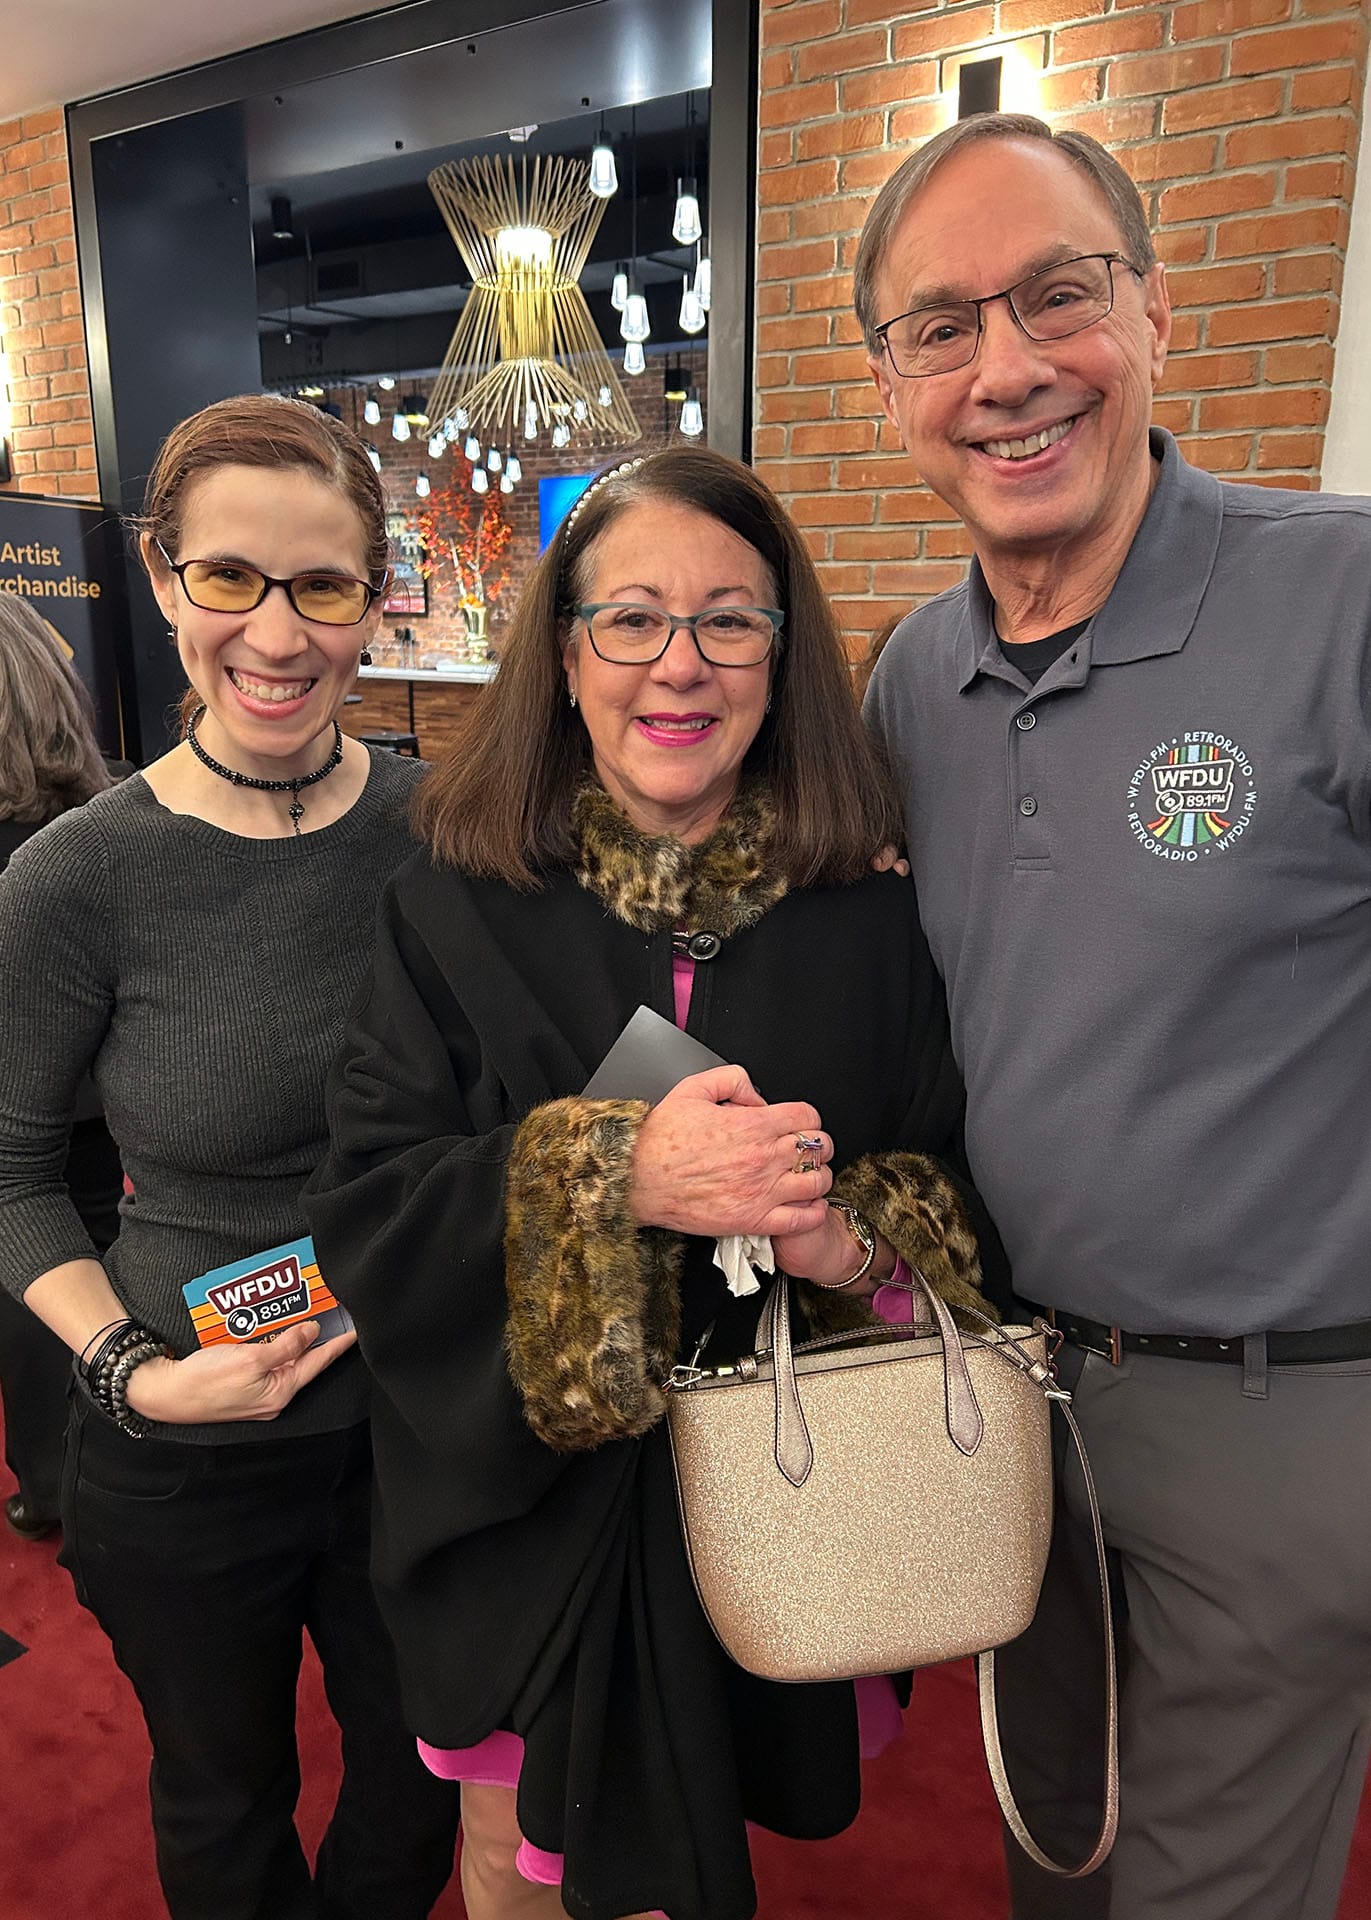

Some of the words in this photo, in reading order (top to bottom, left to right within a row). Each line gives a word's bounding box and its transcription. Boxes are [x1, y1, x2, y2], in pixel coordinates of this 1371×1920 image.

[1, 542, 61, 566] Artist
[1184, 731, 1253, 776] RETRORADIO
[1158, 767, 1224, 788] WFDU
[1127, 812, 1198, 862] RETRORADIO
[215, 1266, 295, 1310] WFDU
